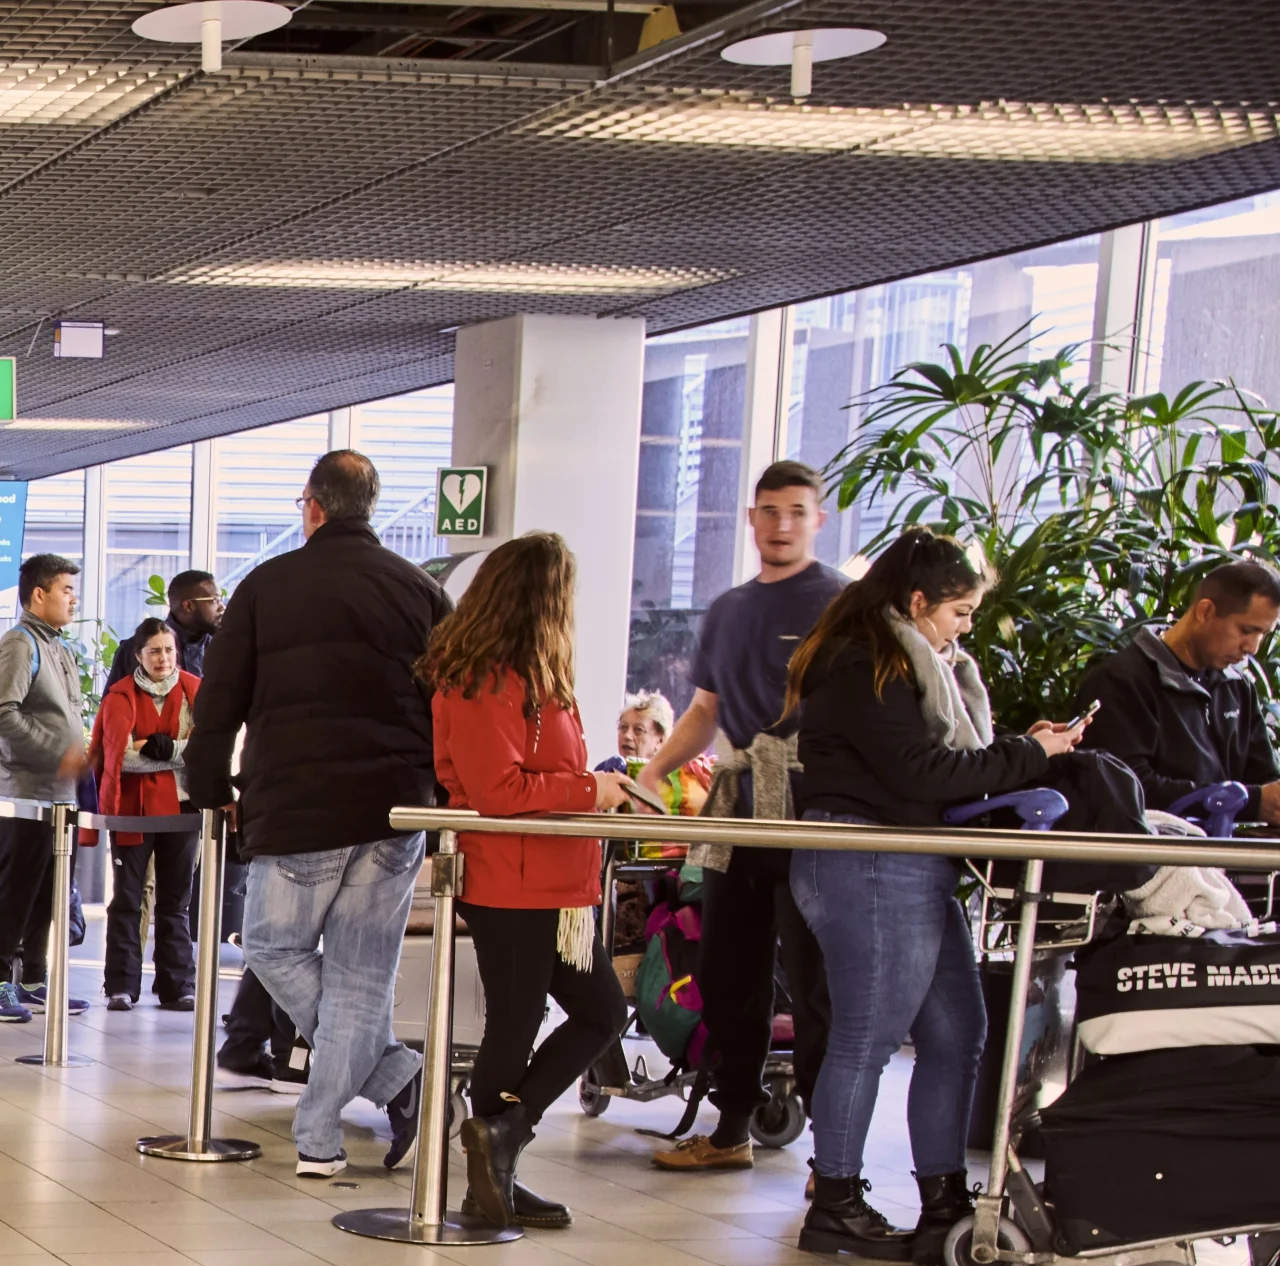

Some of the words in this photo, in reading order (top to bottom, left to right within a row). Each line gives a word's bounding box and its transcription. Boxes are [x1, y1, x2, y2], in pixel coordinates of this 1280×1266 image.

[441, 518, 478, 531] AED
[1116, 962, 1197, 992] STEVE
[1206, 963, 1280, 987] MADD
